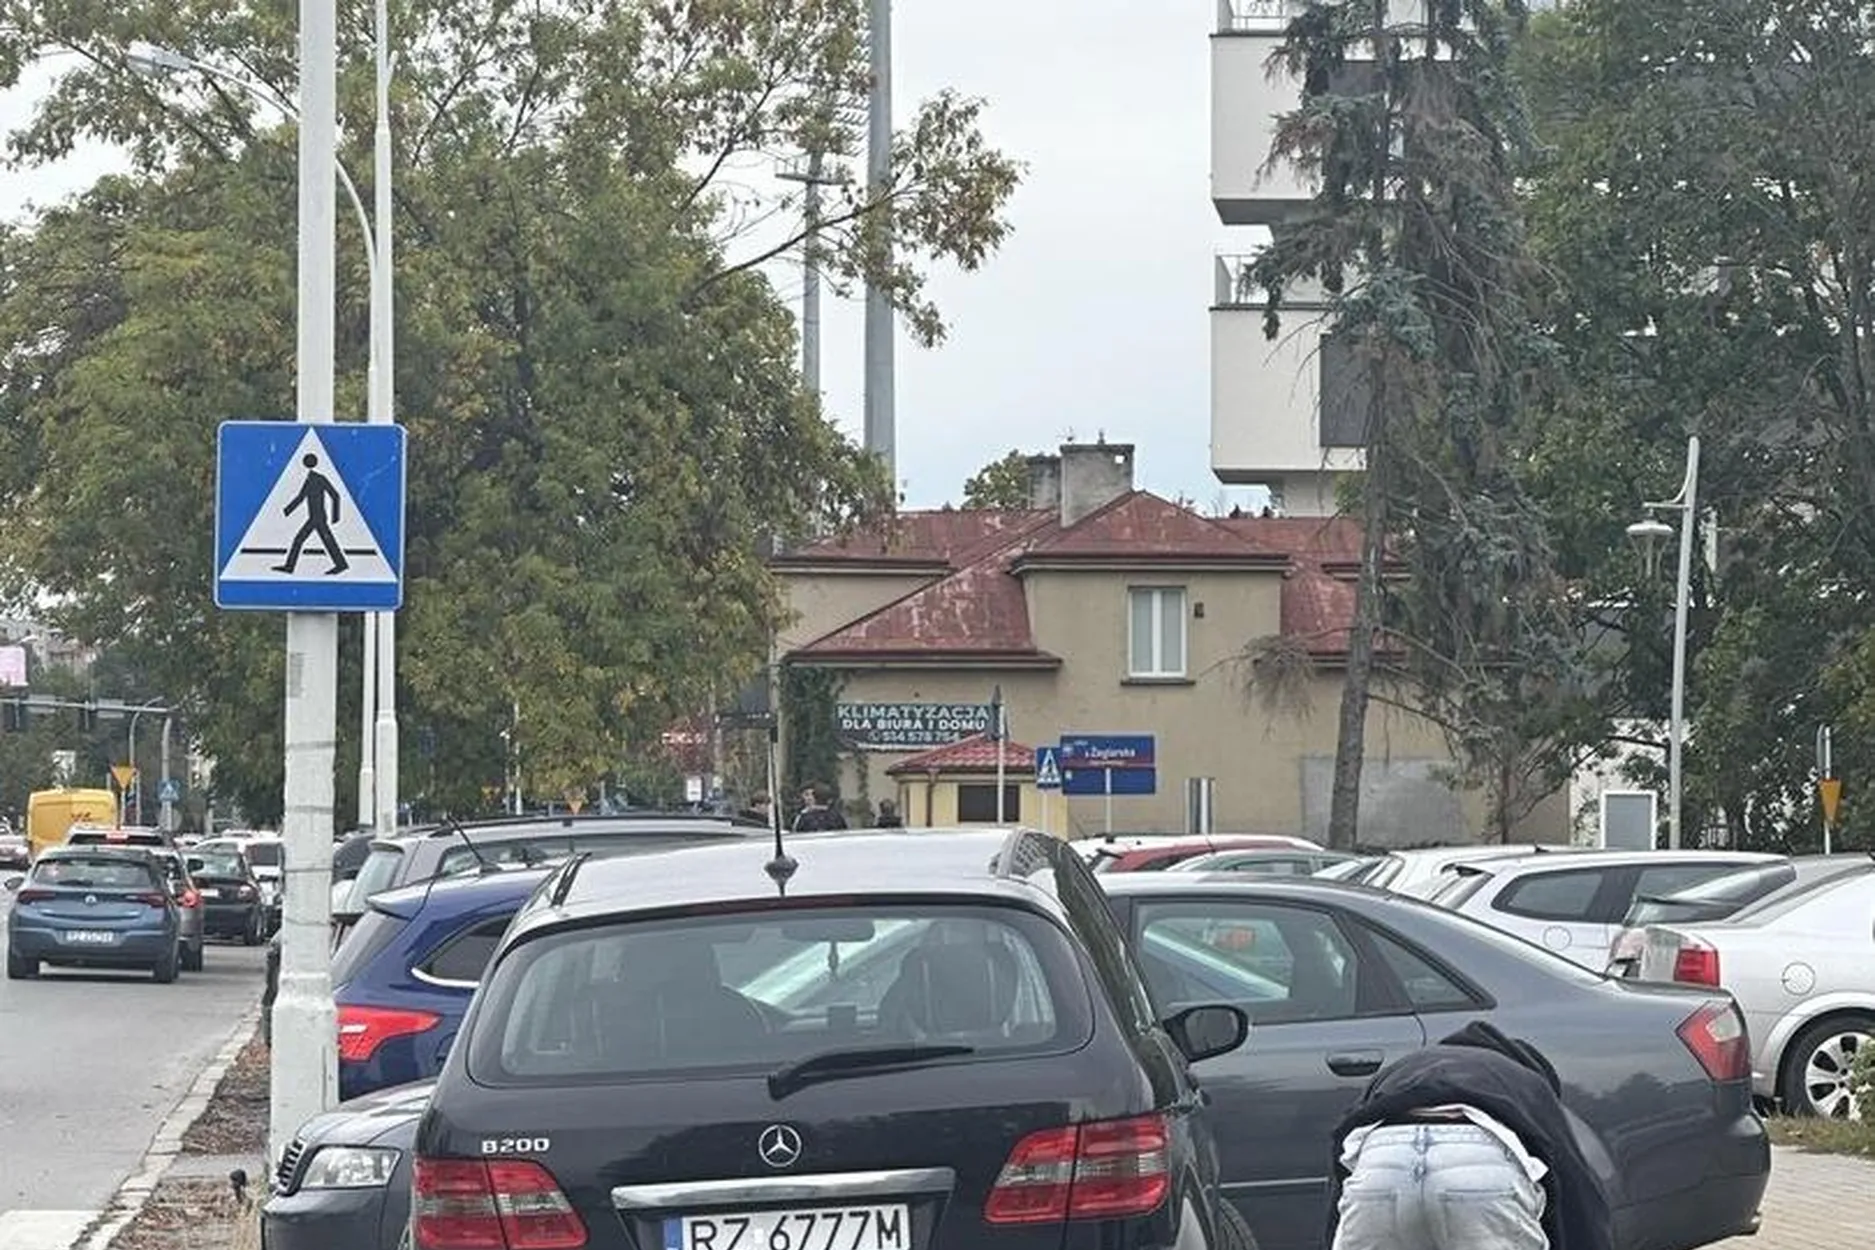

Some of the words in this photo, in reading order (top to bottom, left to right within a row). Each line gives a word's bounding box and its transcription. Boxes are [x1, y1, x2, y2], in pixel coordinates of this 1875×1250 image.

[837, 705, 989, 719] KLIMATYZACJA
[842, 719, 872, 730] DLA
[876, 719, 923, 730] BIURA
[938, 719, 985, 730] DOMU
[482, 1137, 550, 1154] B200
